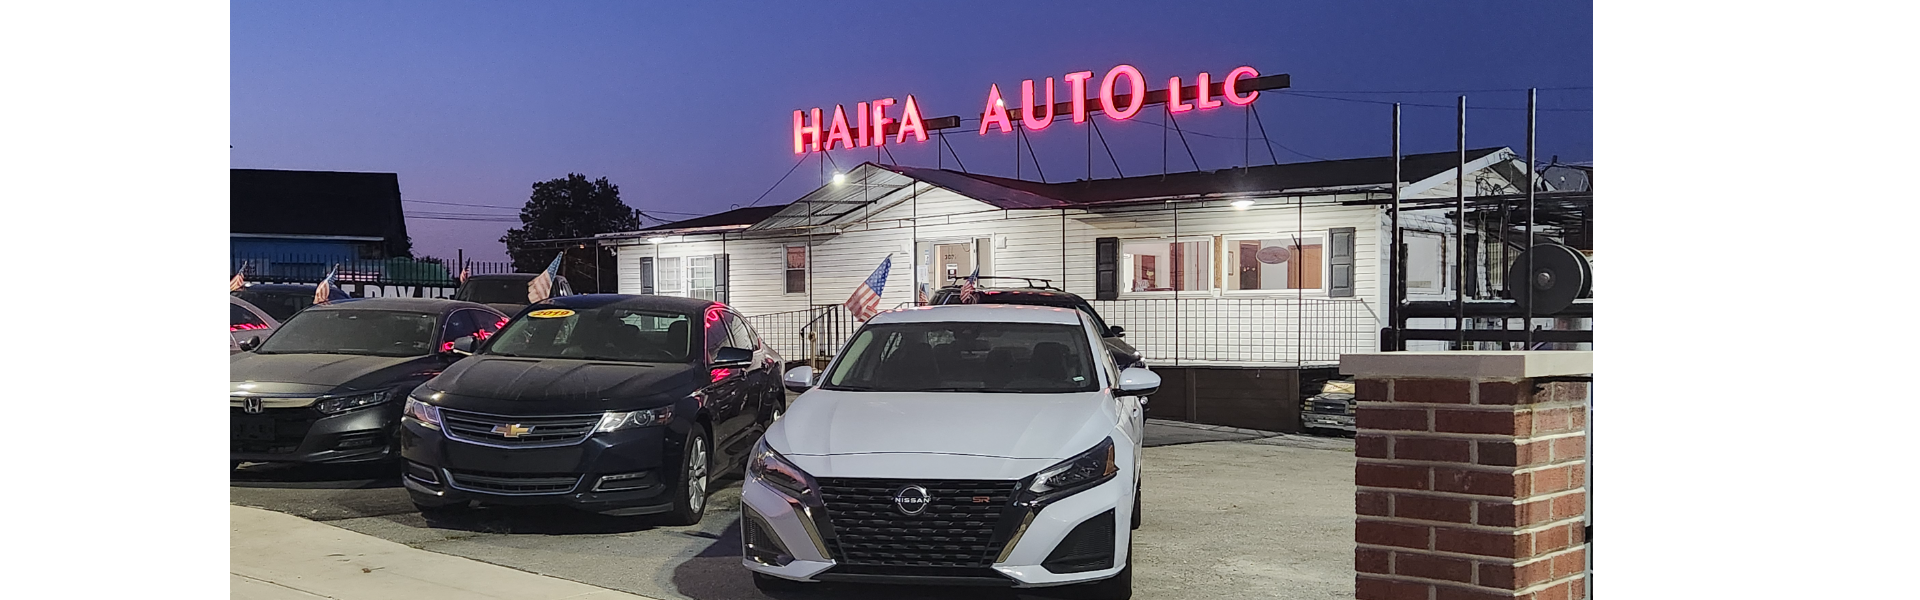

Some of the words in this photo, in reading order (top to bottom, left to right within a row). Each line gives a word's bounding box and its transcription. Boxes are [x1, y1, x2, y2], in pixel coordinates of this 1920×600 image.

[794, 94, 929, 154] HAIFA
[979, 64, 1146, 135] AUTO
[1168, 65, 1260, 113] LLC
